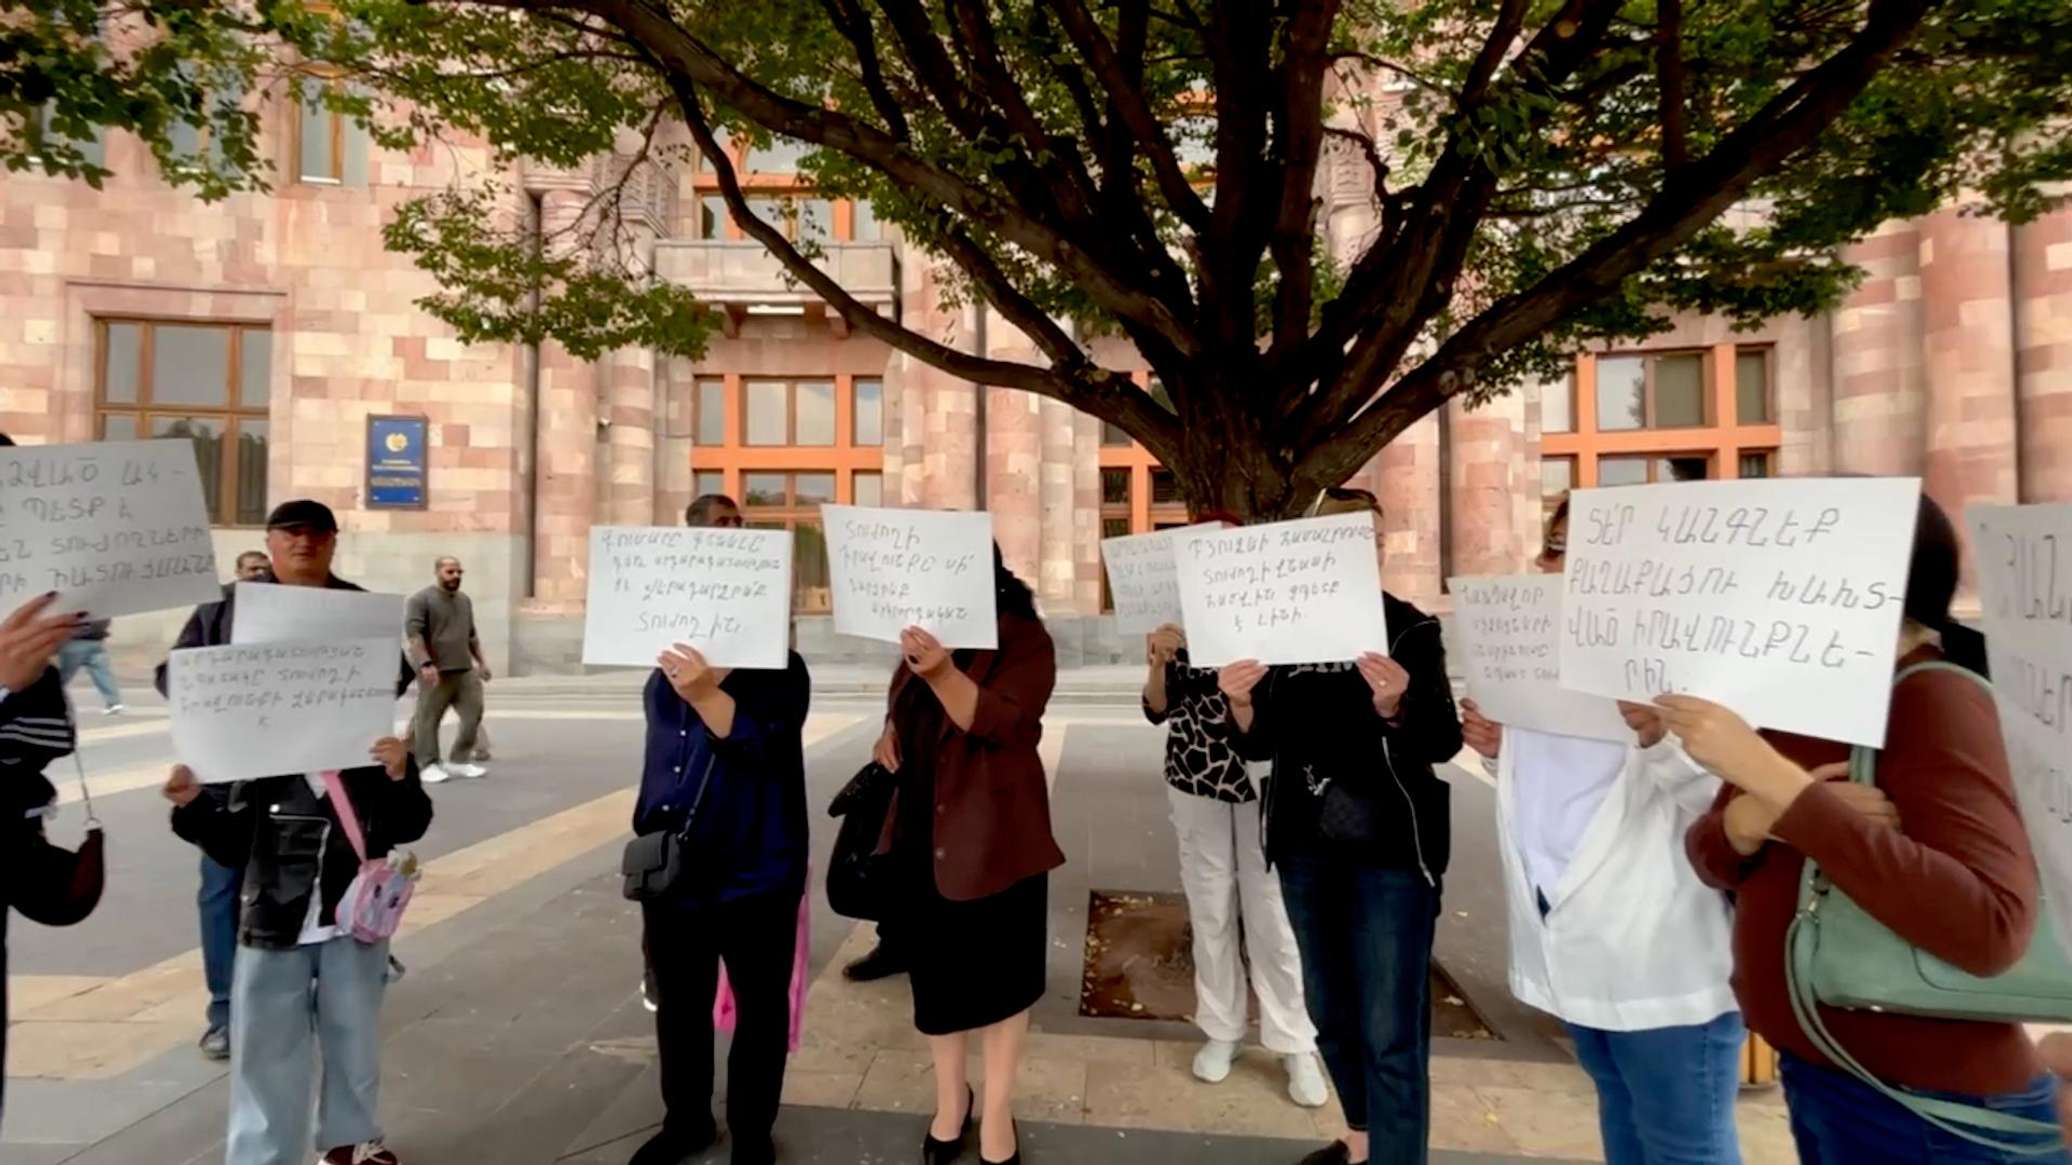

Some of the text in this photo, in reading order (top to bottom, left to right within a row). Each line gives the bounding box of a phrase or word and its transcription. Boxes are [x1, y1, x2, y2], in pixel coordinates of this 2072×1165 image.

[845, 520, 922, 551] ՏՈՒԺՈՂԻ
[1656, 505, 1840, 548] ԿԱՆԳՆԵՔ
[1203, 560, 1271, 586] ՏՈՒԺՈՂԻ
[1568, 557, 1739, 597] ՔԱՂԱՔԱՑՈՒ
[1567, 604, 1619, 648] ՎԱԾ
